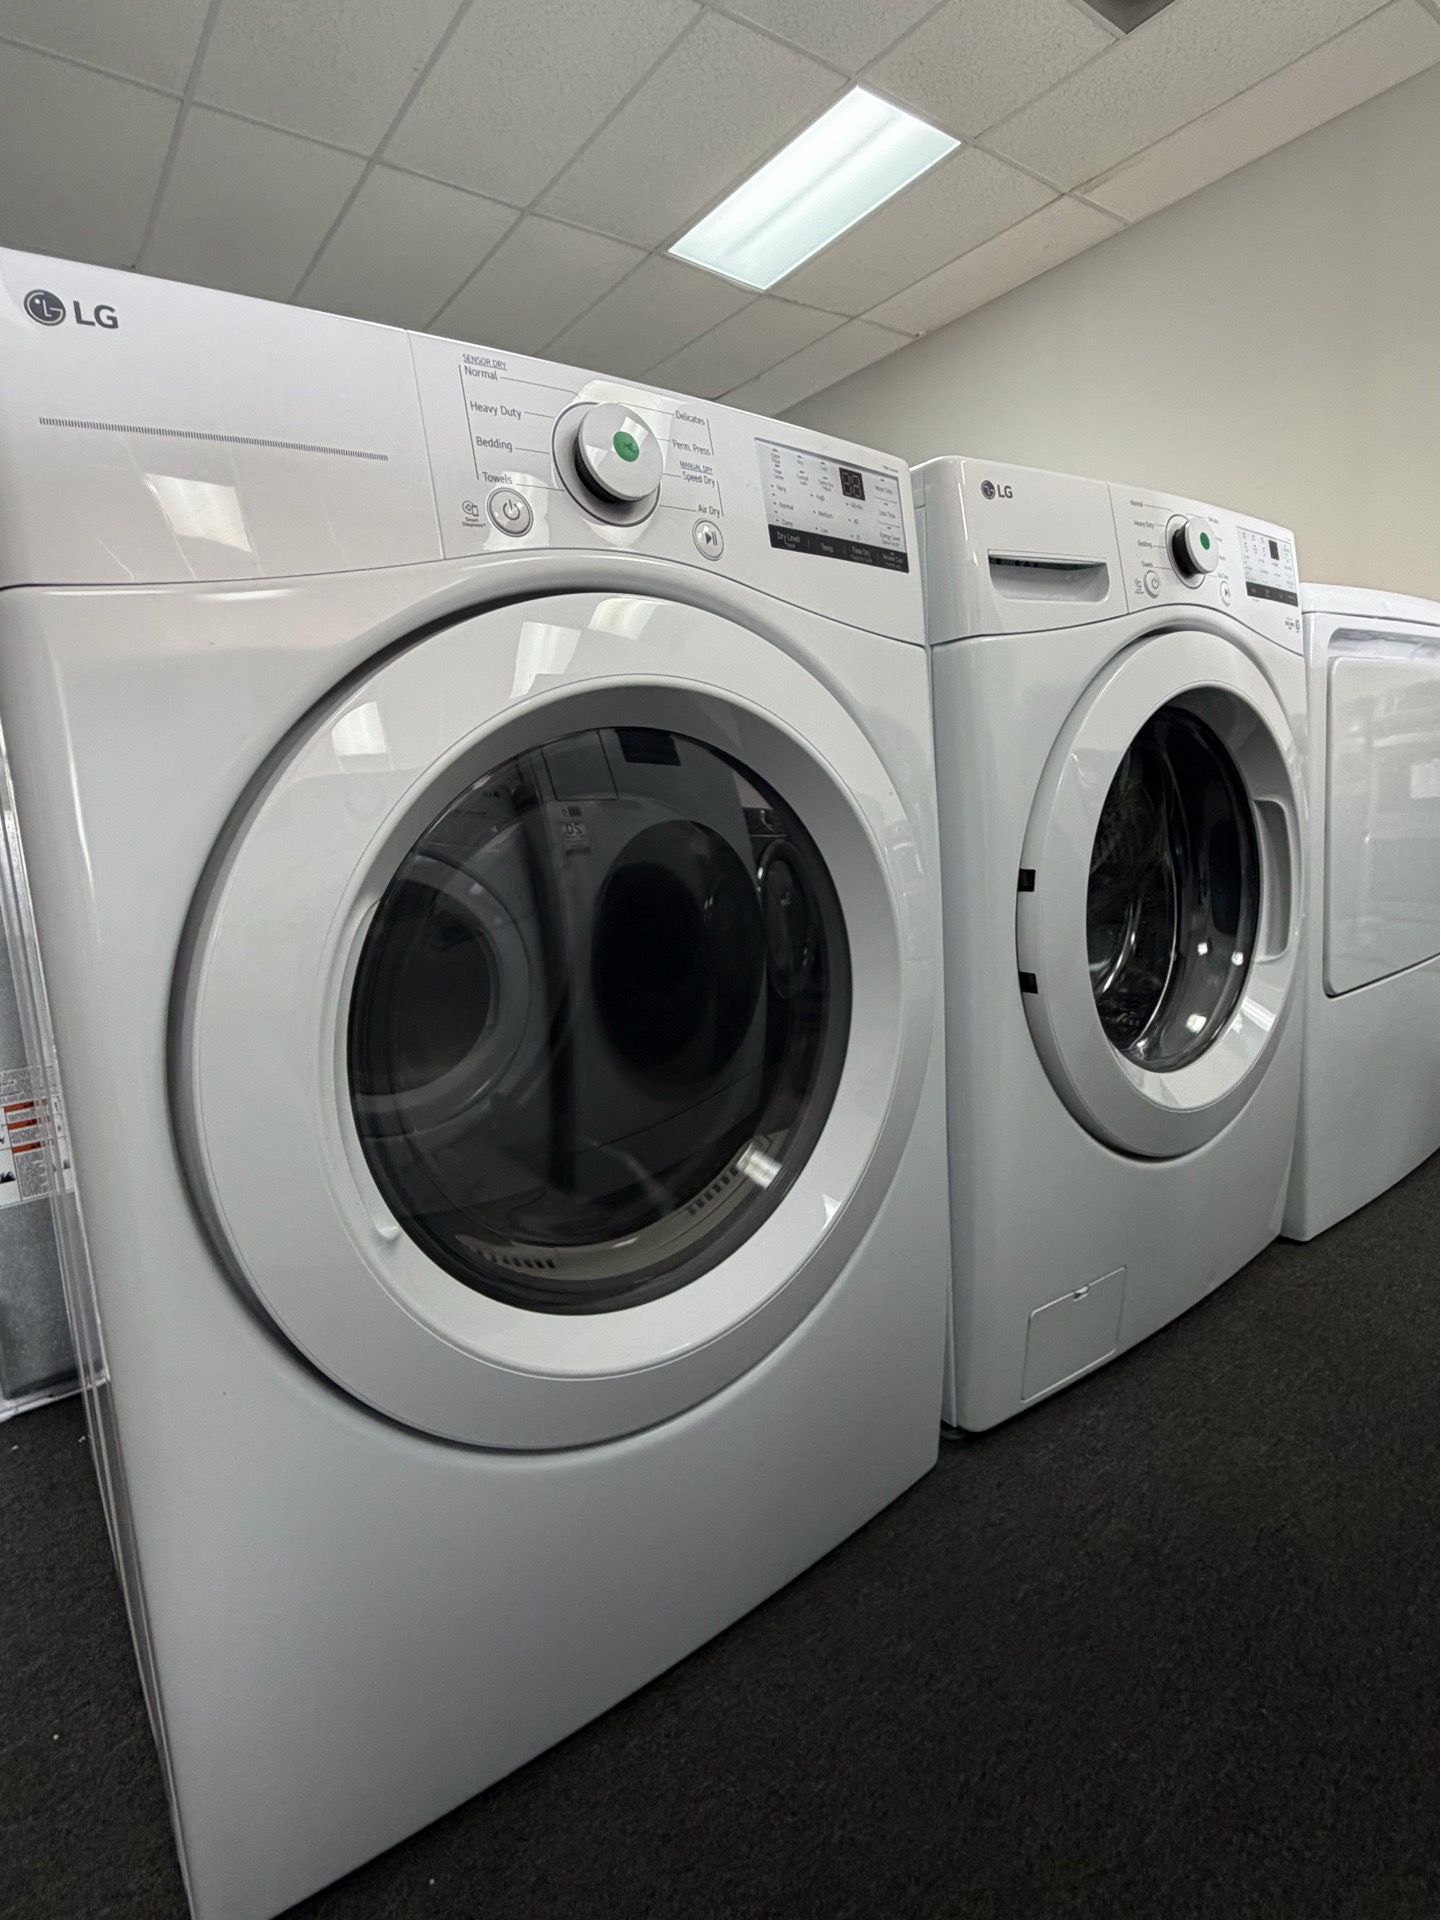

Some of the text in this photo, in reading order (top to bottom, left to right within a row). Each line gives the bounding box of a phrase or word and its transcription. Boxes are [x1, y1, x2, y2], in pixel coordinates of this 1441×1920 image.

[72, 300, 119, 329] LG
[462, 353, 507, 369] SENSOR DRY
[464, 365, 498, 380] Normal
[469, 400, 522, 420] Heavy Duty
[675, 410, 705, 426] Delicates
[476, 436, 513, 453] Bedding
[672, 439, 711, 456] Perm. Press
[482, 471, 513, 485] Towels
[682, 471, 715, 488] Speed Dry
[997, 484, 1014, 499] LG
[698, 504, 720, 518] Air Dry
